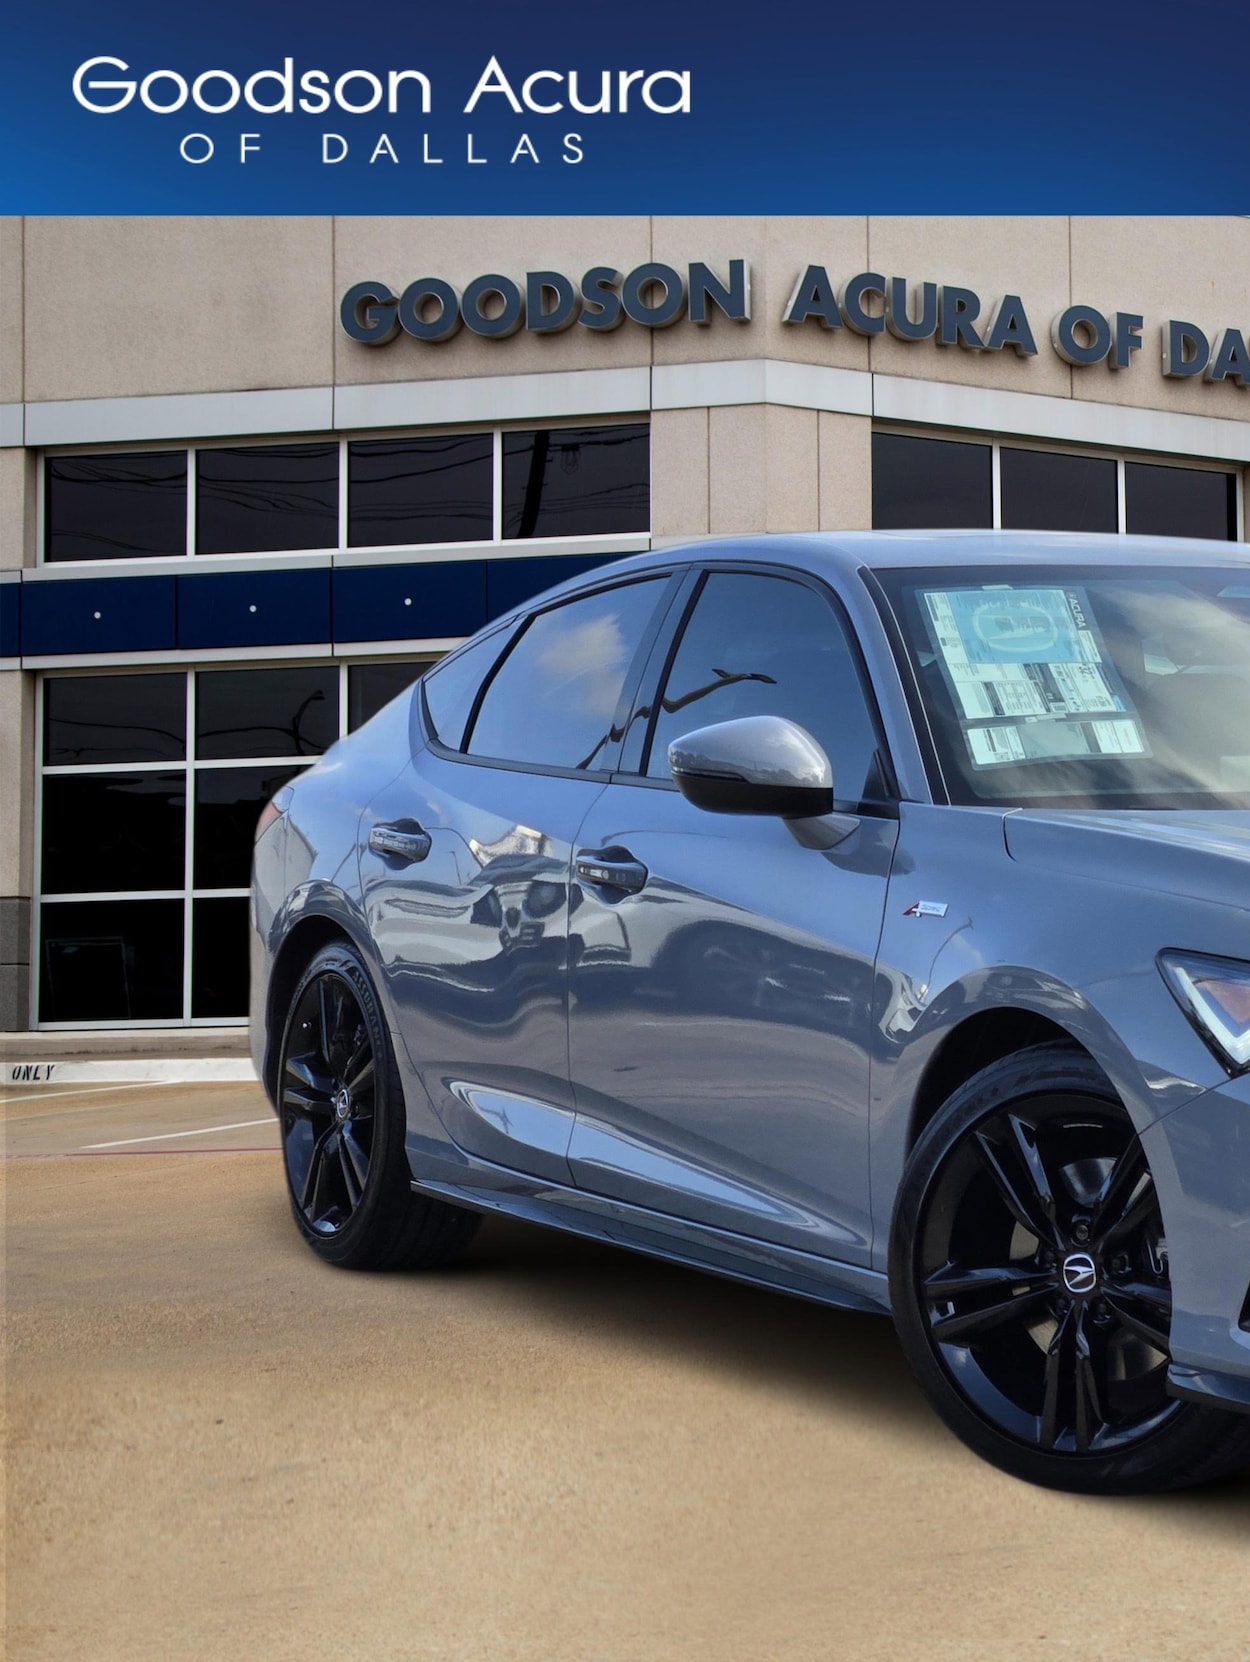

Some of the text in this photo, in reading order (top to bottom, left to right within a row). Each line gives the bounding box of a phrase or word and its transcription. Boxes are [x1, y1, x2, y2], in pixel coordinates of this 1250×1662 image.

[341, 259, 750, 346] GOODSON
[782, 265, 1038, 357] ACURA
[1051, 305, 1144, 369] OF
[1069, 598, 1087, 628] ACURA
[12, 1064, 55, 1080] ONLY
